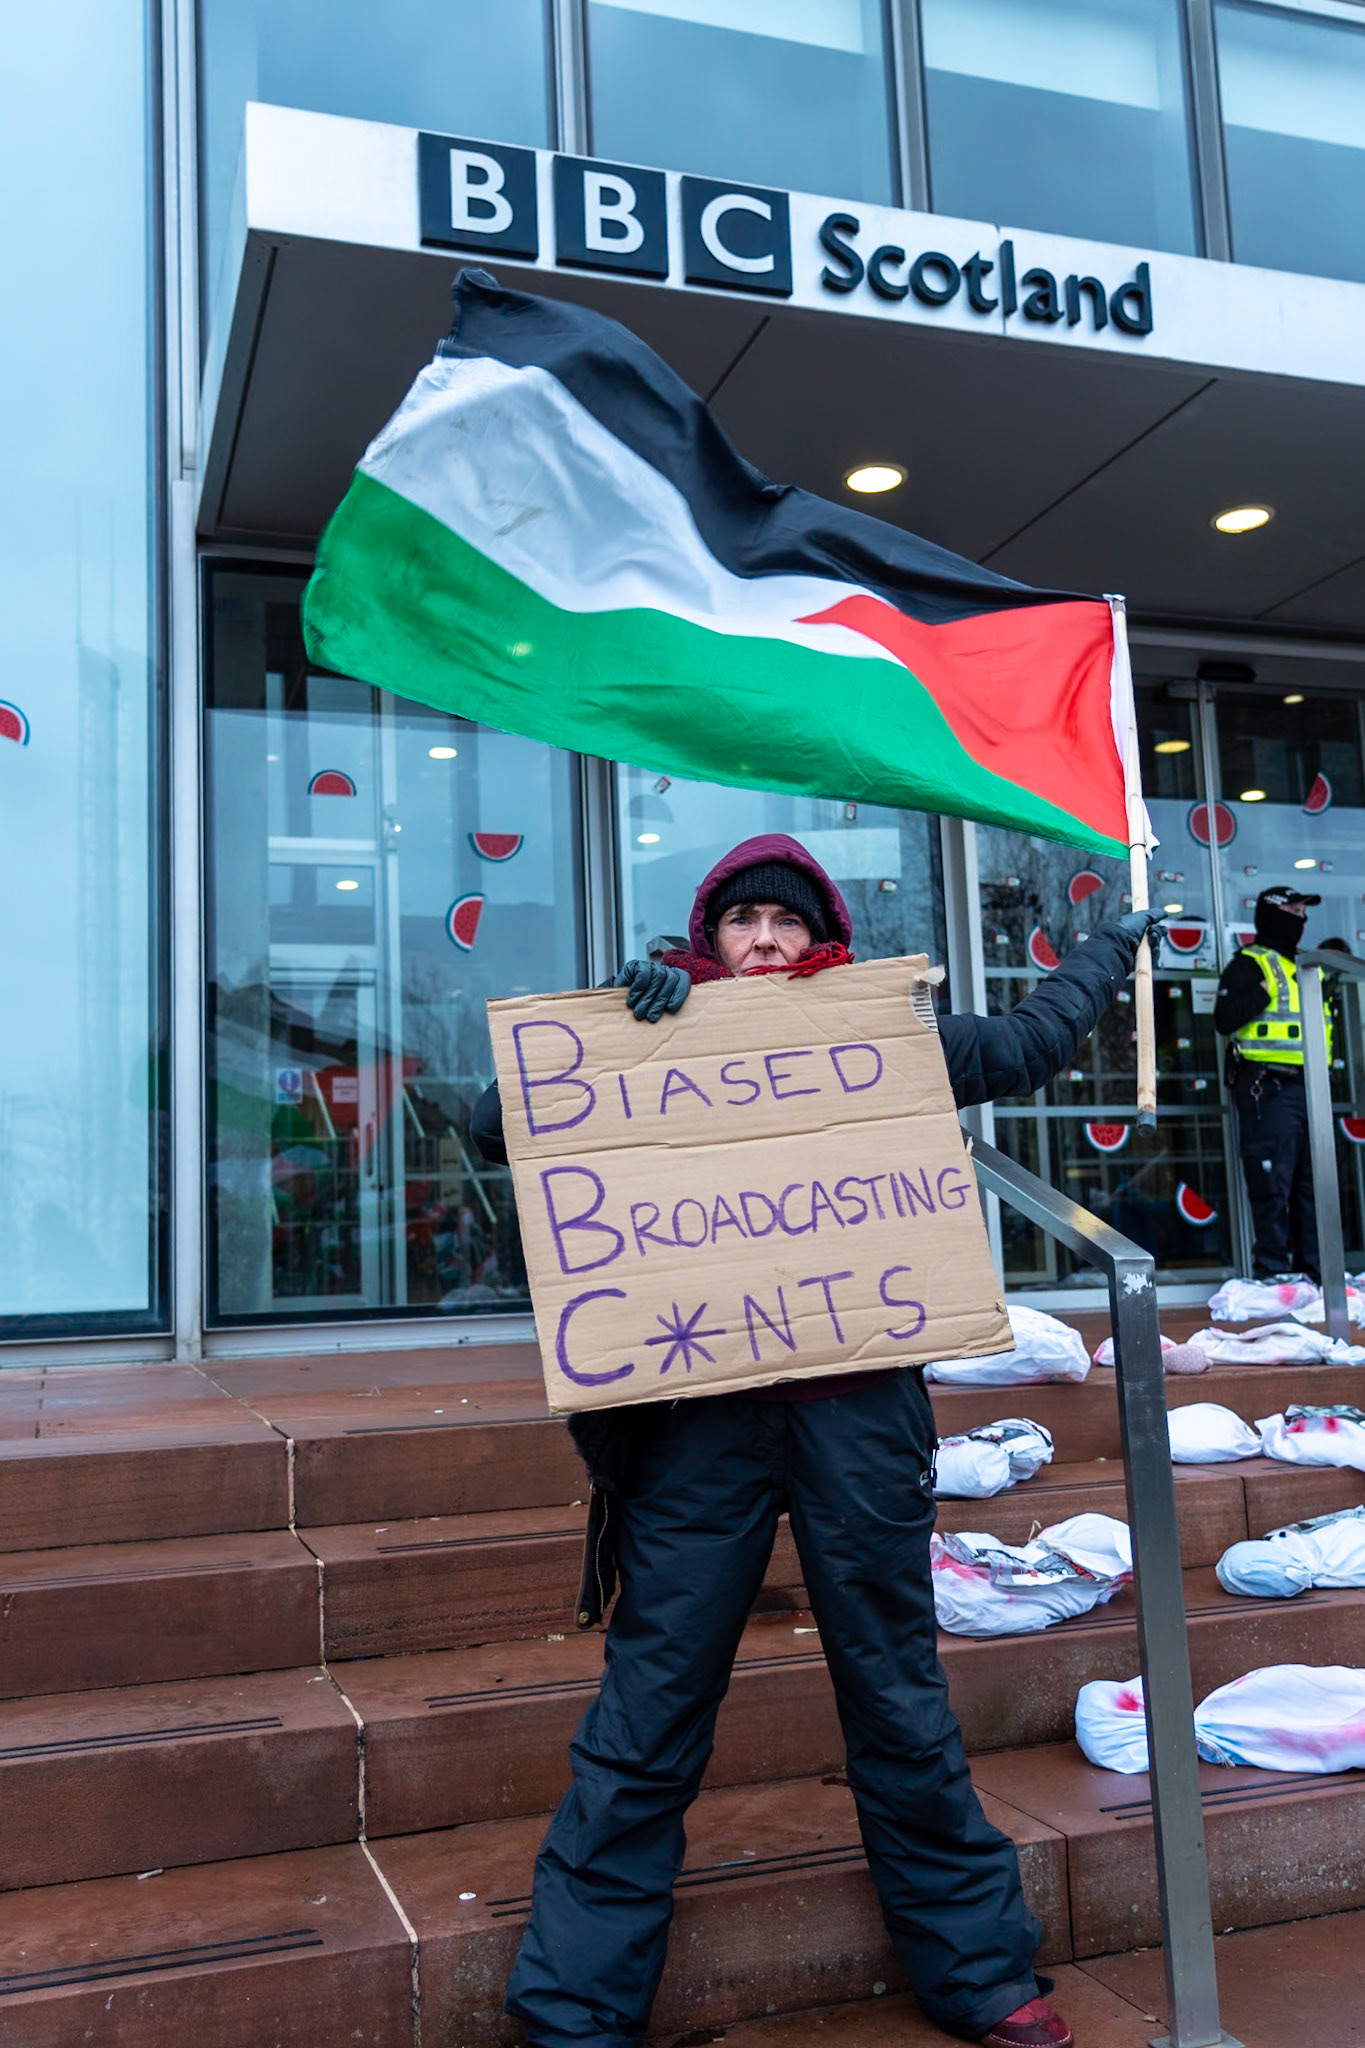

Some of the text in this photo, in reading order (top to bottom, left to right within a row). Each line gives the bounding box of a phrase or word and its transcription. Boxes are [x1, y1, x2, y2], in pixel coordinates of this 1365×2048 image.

[448, 147, 1154, 336] BBC Scotland
[512, 1019, 884, 1137] BIASED
[540, 1165, 972, 1276] BROADCASTING
